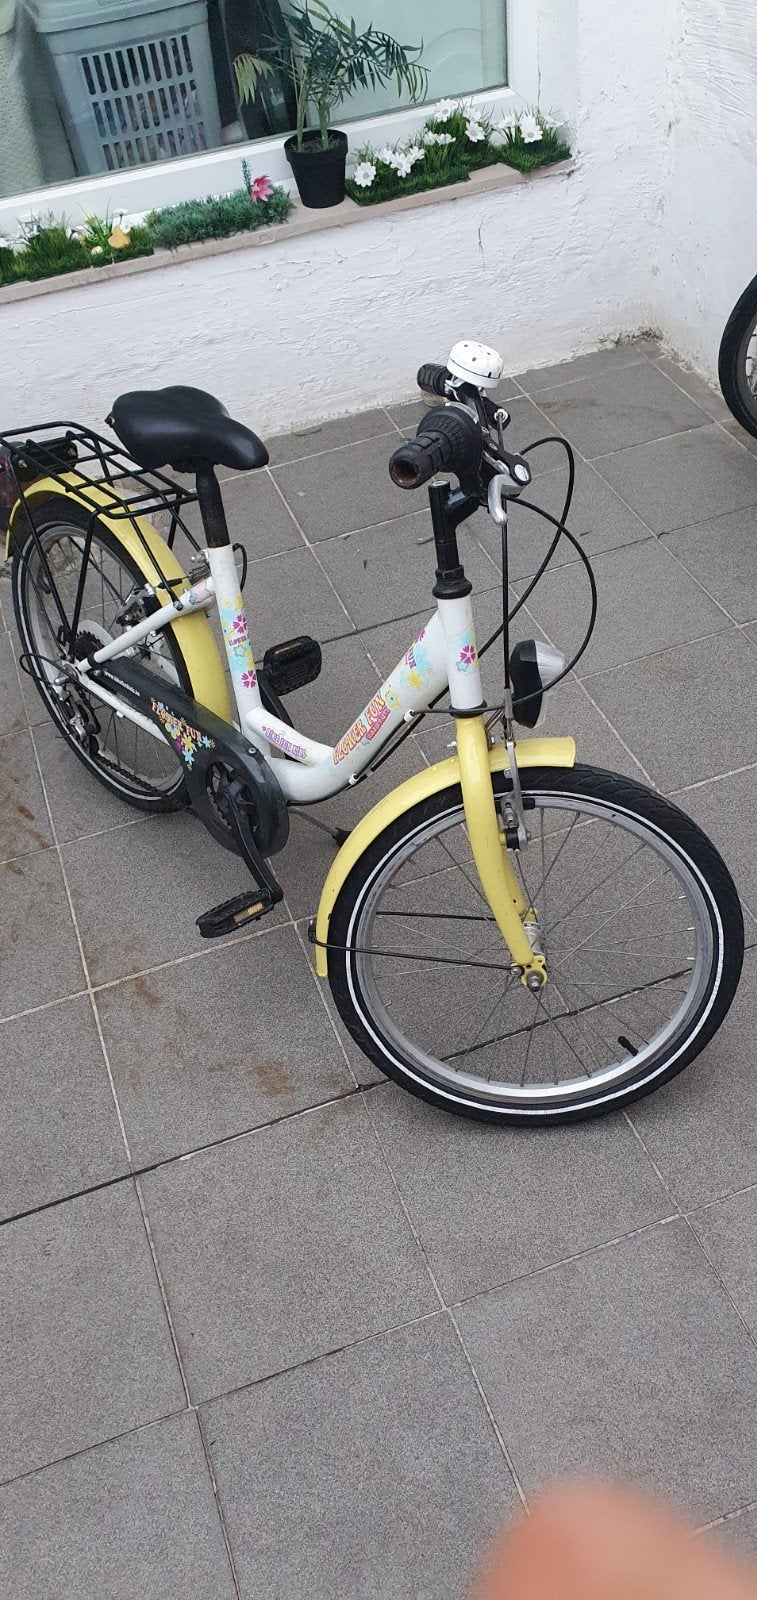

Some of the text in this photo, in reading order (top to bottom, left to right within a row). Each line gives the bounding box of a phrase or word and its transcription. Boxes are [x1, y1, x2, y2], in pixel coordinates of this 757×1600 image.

[151, 700, 202, 742] FLOWER FUN
[333, 691, 386, 765] FLOWER FUN
